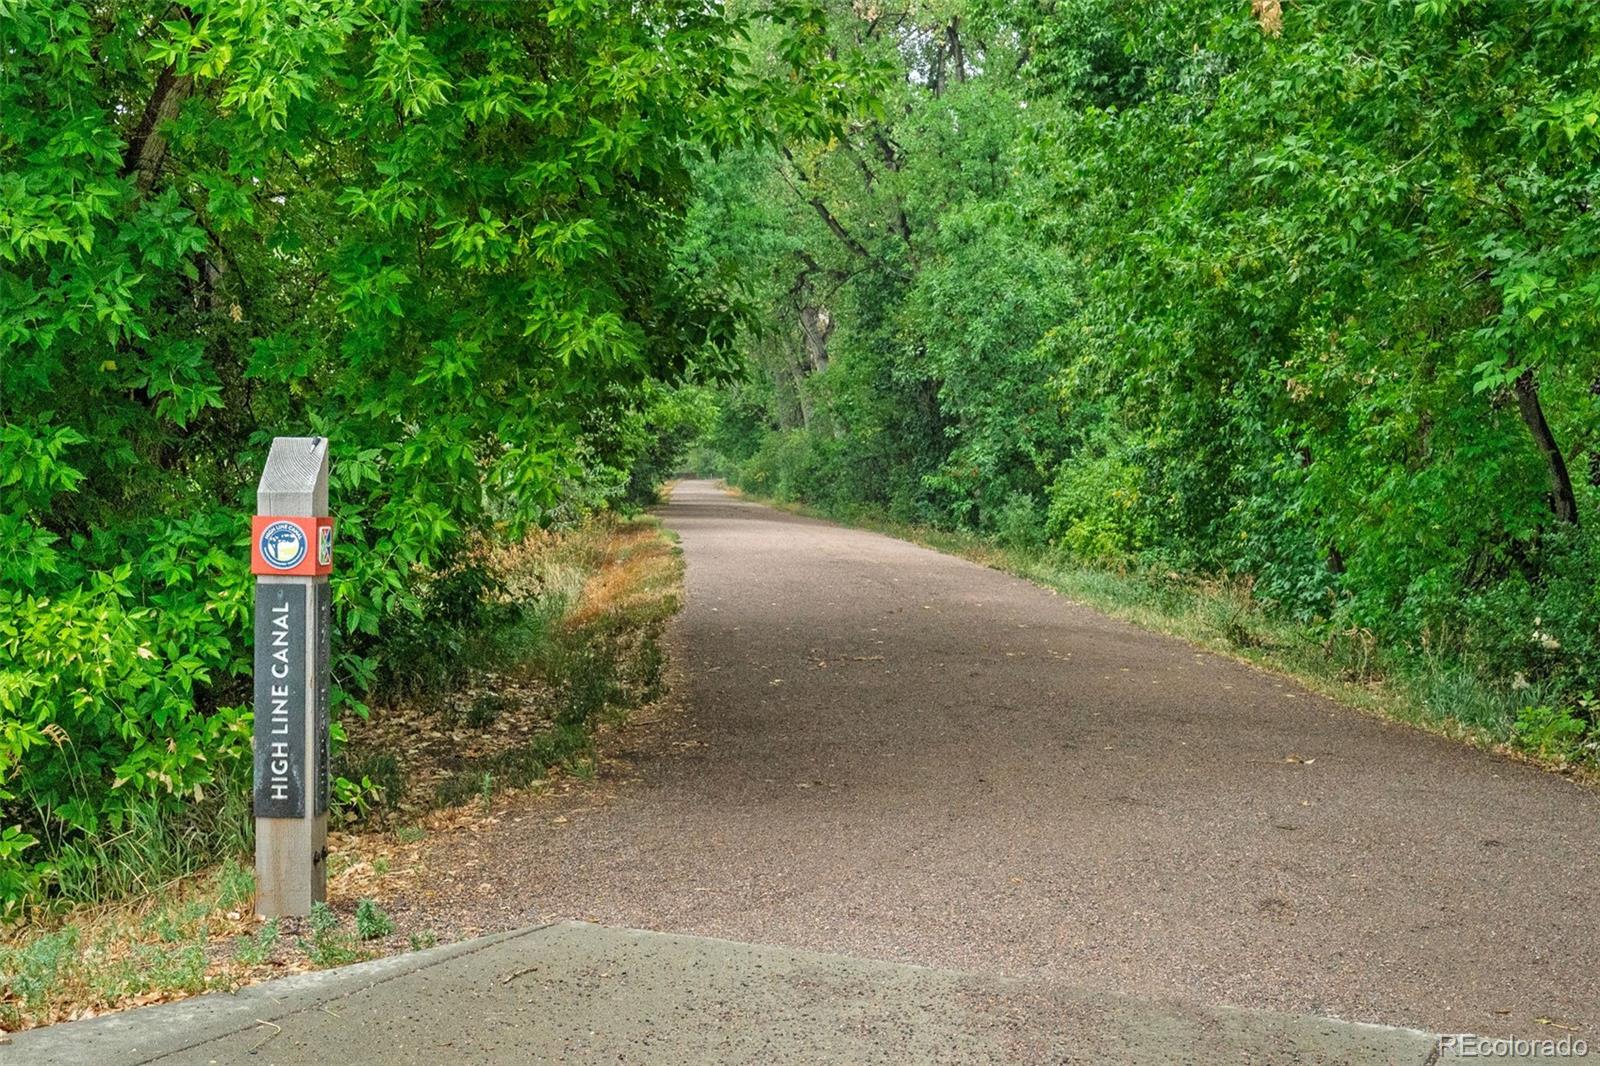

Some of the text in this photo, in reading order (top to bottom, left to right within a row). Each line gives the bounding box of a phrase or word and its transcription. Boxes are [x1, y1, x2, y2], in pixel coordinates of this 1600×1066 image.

[271, 601, 290, 800] HIGH LINE CANAL
